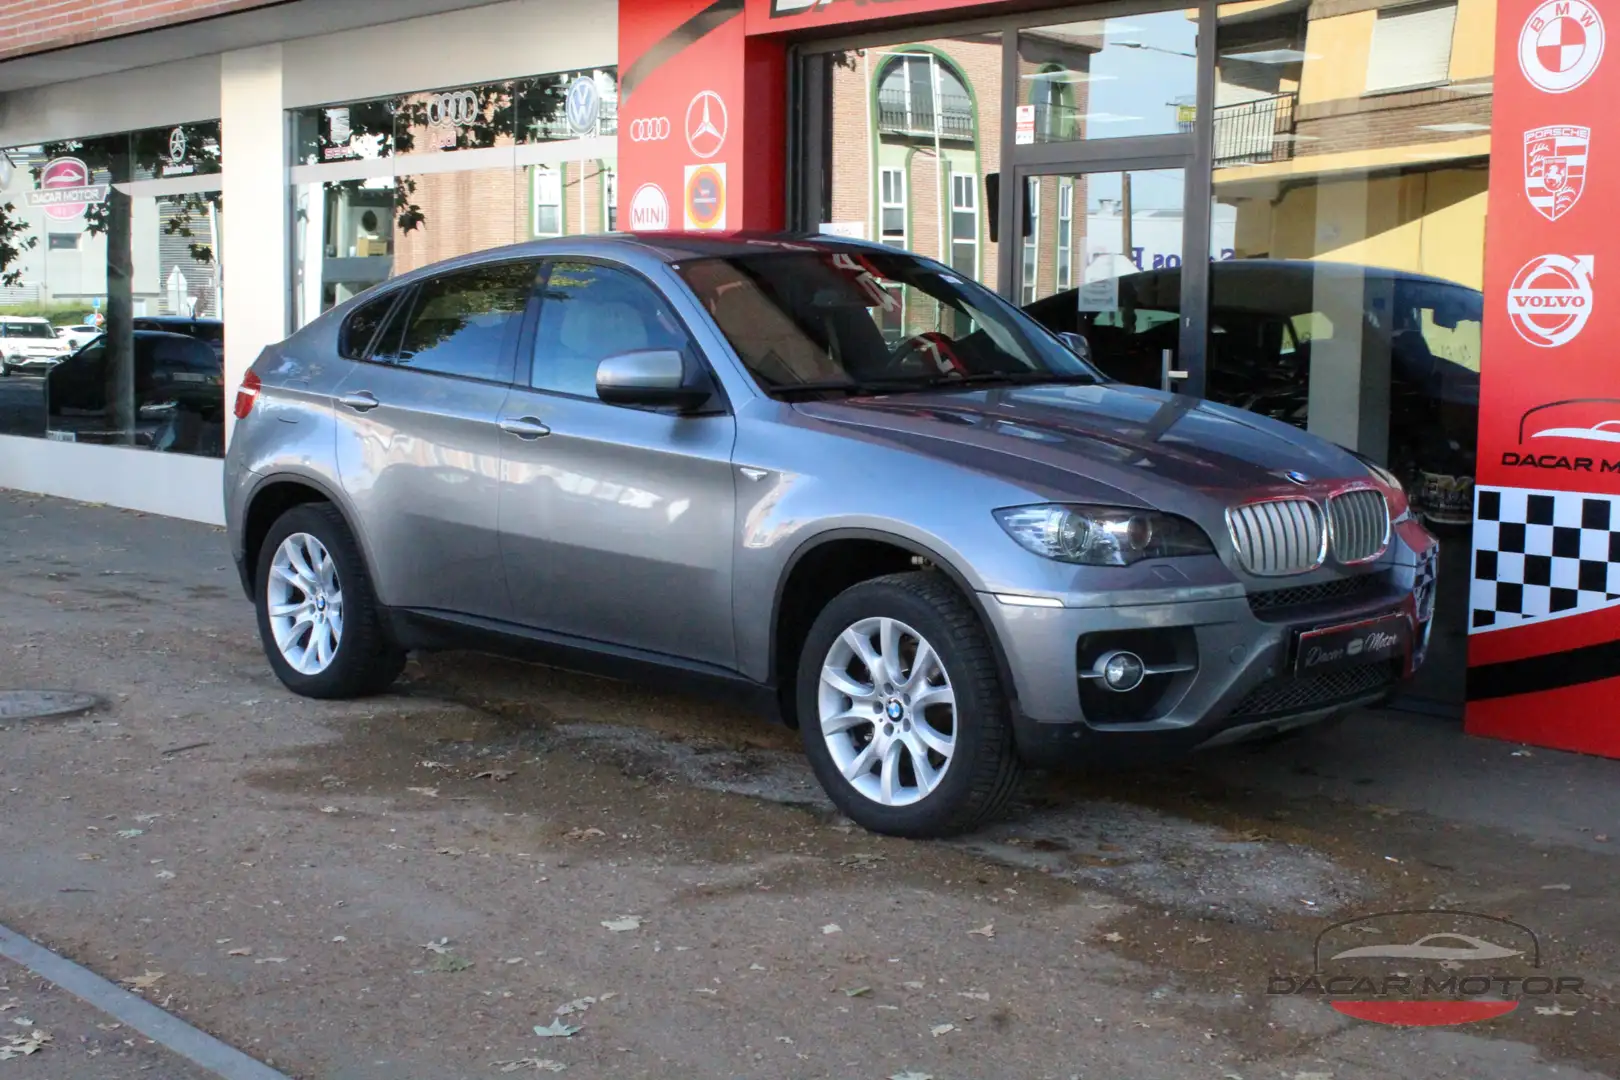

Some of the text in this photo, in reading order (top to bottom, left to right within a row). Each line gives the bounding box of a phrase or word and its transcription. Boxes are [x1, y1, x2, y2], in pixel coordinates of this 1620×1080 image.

[1530, 2, 1596, 33] BMW
[1525, 128, 1588, 142] PORSCHE
[63, 188, 100, 201] MOTOR
[633, 206, 664, 224] MINI
[1513, 295, 1585, 308] VOLVO
[1501, 452, 1593, 472] DACAR
